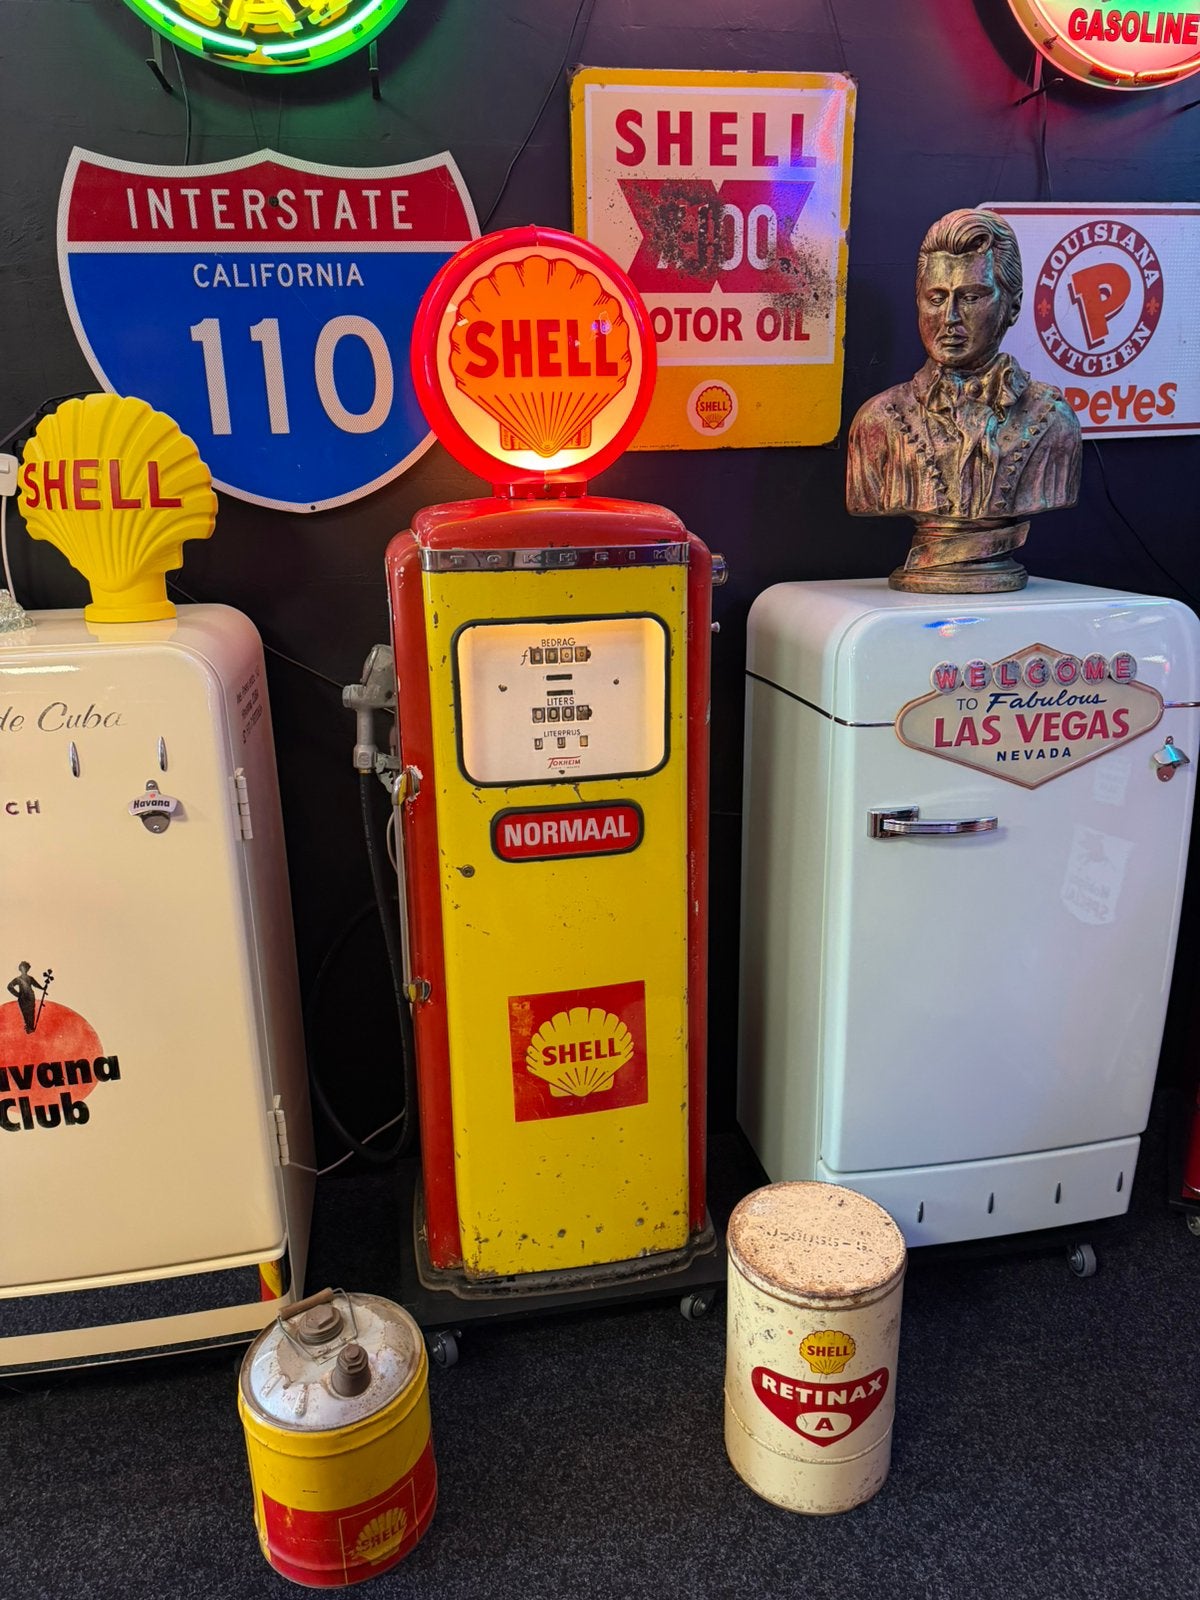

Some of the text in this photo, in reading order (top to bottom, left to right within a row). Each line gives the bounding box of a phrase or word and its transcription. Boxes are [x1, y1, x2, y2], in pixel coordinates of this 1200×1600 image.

[1068, 8, 1200, 45] GASOLINE
[615, 109, 817, 167] SHELL
[126, 188, 413, 230] INTERSTATE
[1039, 223, 1161, 290] LOUISIANA
[193, 262, 364, 288] CALIFORNIA
[649, 306, 810, 342] OTOR OIL
[465, 318, 618, 379] SHELL
[1041, 321, 1152, 374] KITCHEN
[190, 315, 394, 436] 110
[700, 401, 728, 412] SHELL
[23, 458, 182, 511] SHELL
[541, 637, 576, 647] BEDRAG
[935, 659, 1130, 690] WELCOME
[37, 702, 127, 732] Cuba
[547, 697, 574, 706] LITERS
[956, 689, 1107, 713] TO Fabulous
[934, 708, 1130, 748] LAS VEGAS
[996, 747, 1071, 761] NEVADA
[133, 799, 170, 809] Havana
[503, 814, 631, 847] NORMAAL
[542, 1037, 622, 1066] SHELL
[0, 1055, 121, 1092] vana
[0, 1092, 90, 1132] Club
[807, 1344, 850, 1358] SHELL
[761, 1373, 884, 1407] RETINAX
[814, 1417, 835, 1432] A
[360, 1521, 408, 1550] SHELL
